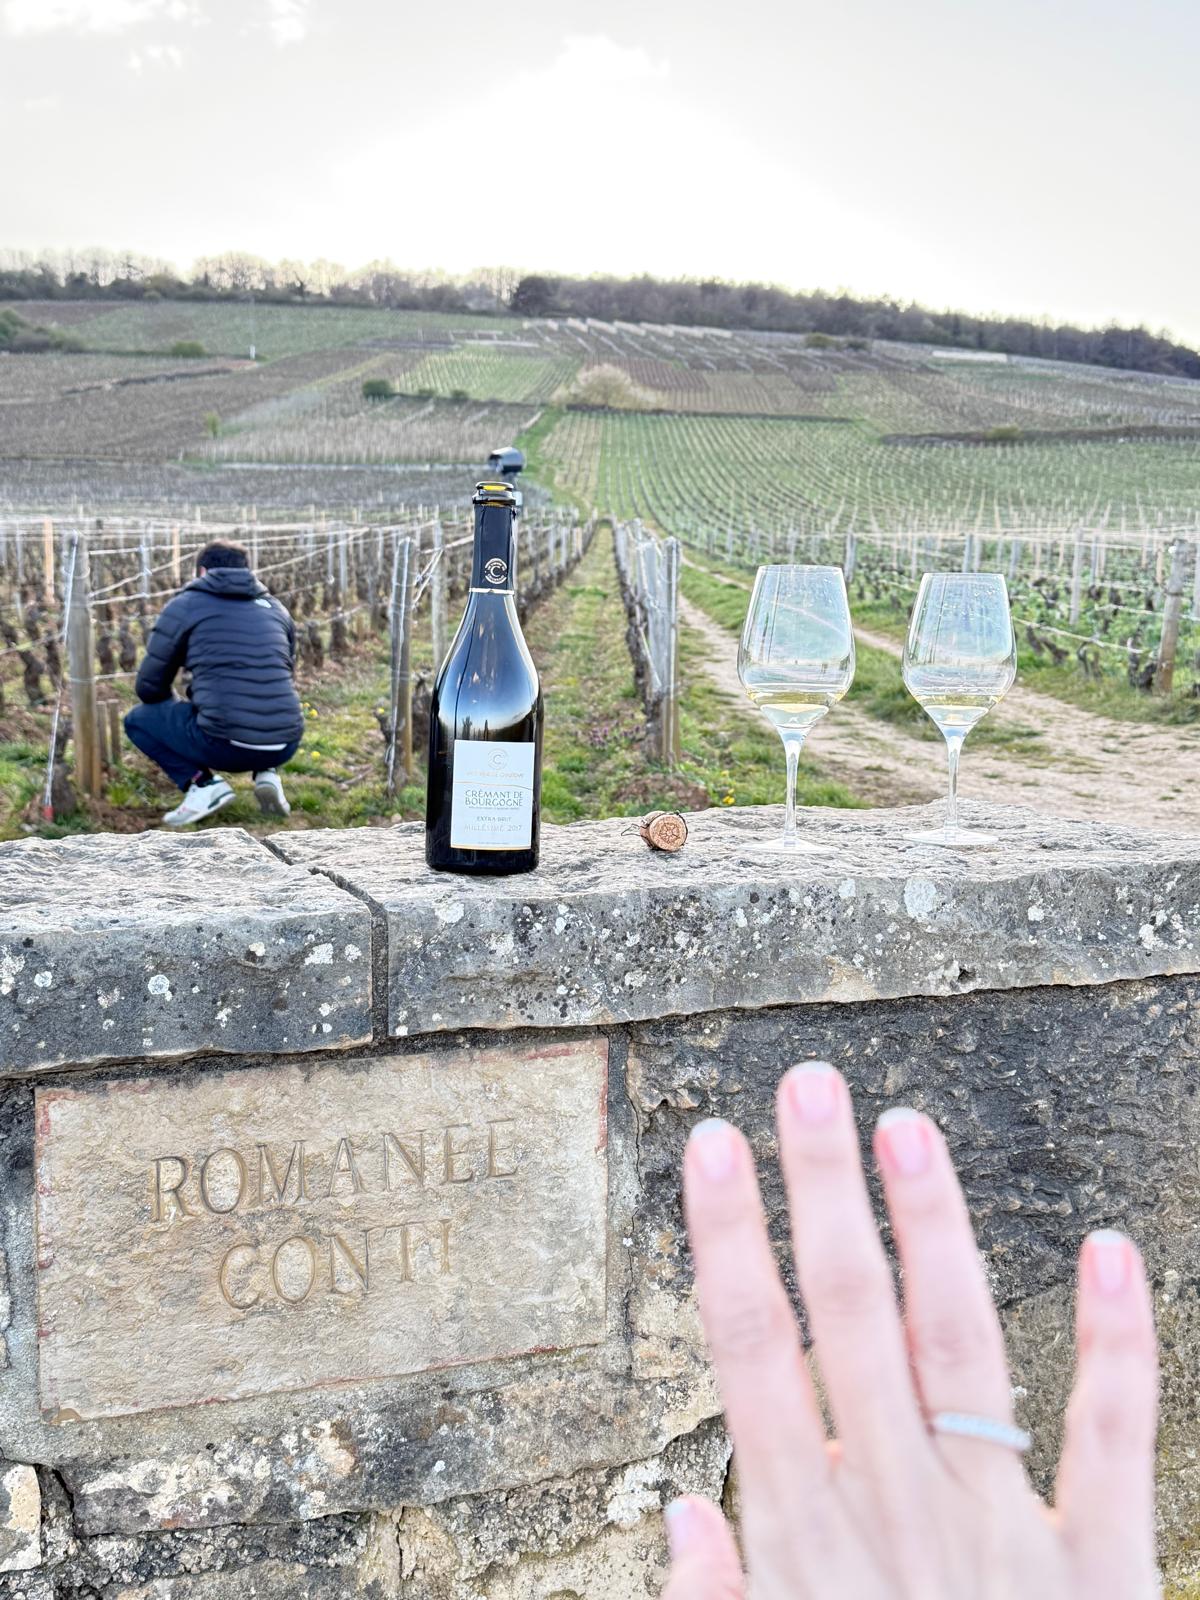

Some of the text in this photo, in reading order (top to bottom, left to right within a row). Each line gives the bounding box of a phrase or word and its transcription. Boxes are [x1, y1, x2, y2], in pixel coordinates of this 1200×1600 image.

[465, 789, 523, 799] CRÉMANT DE
[465, 798, 523, 807] BOURGOGNE
[150, 1118, 520, 1224] ROMANEE
[219, 1219, 452, 1309] CONTI
